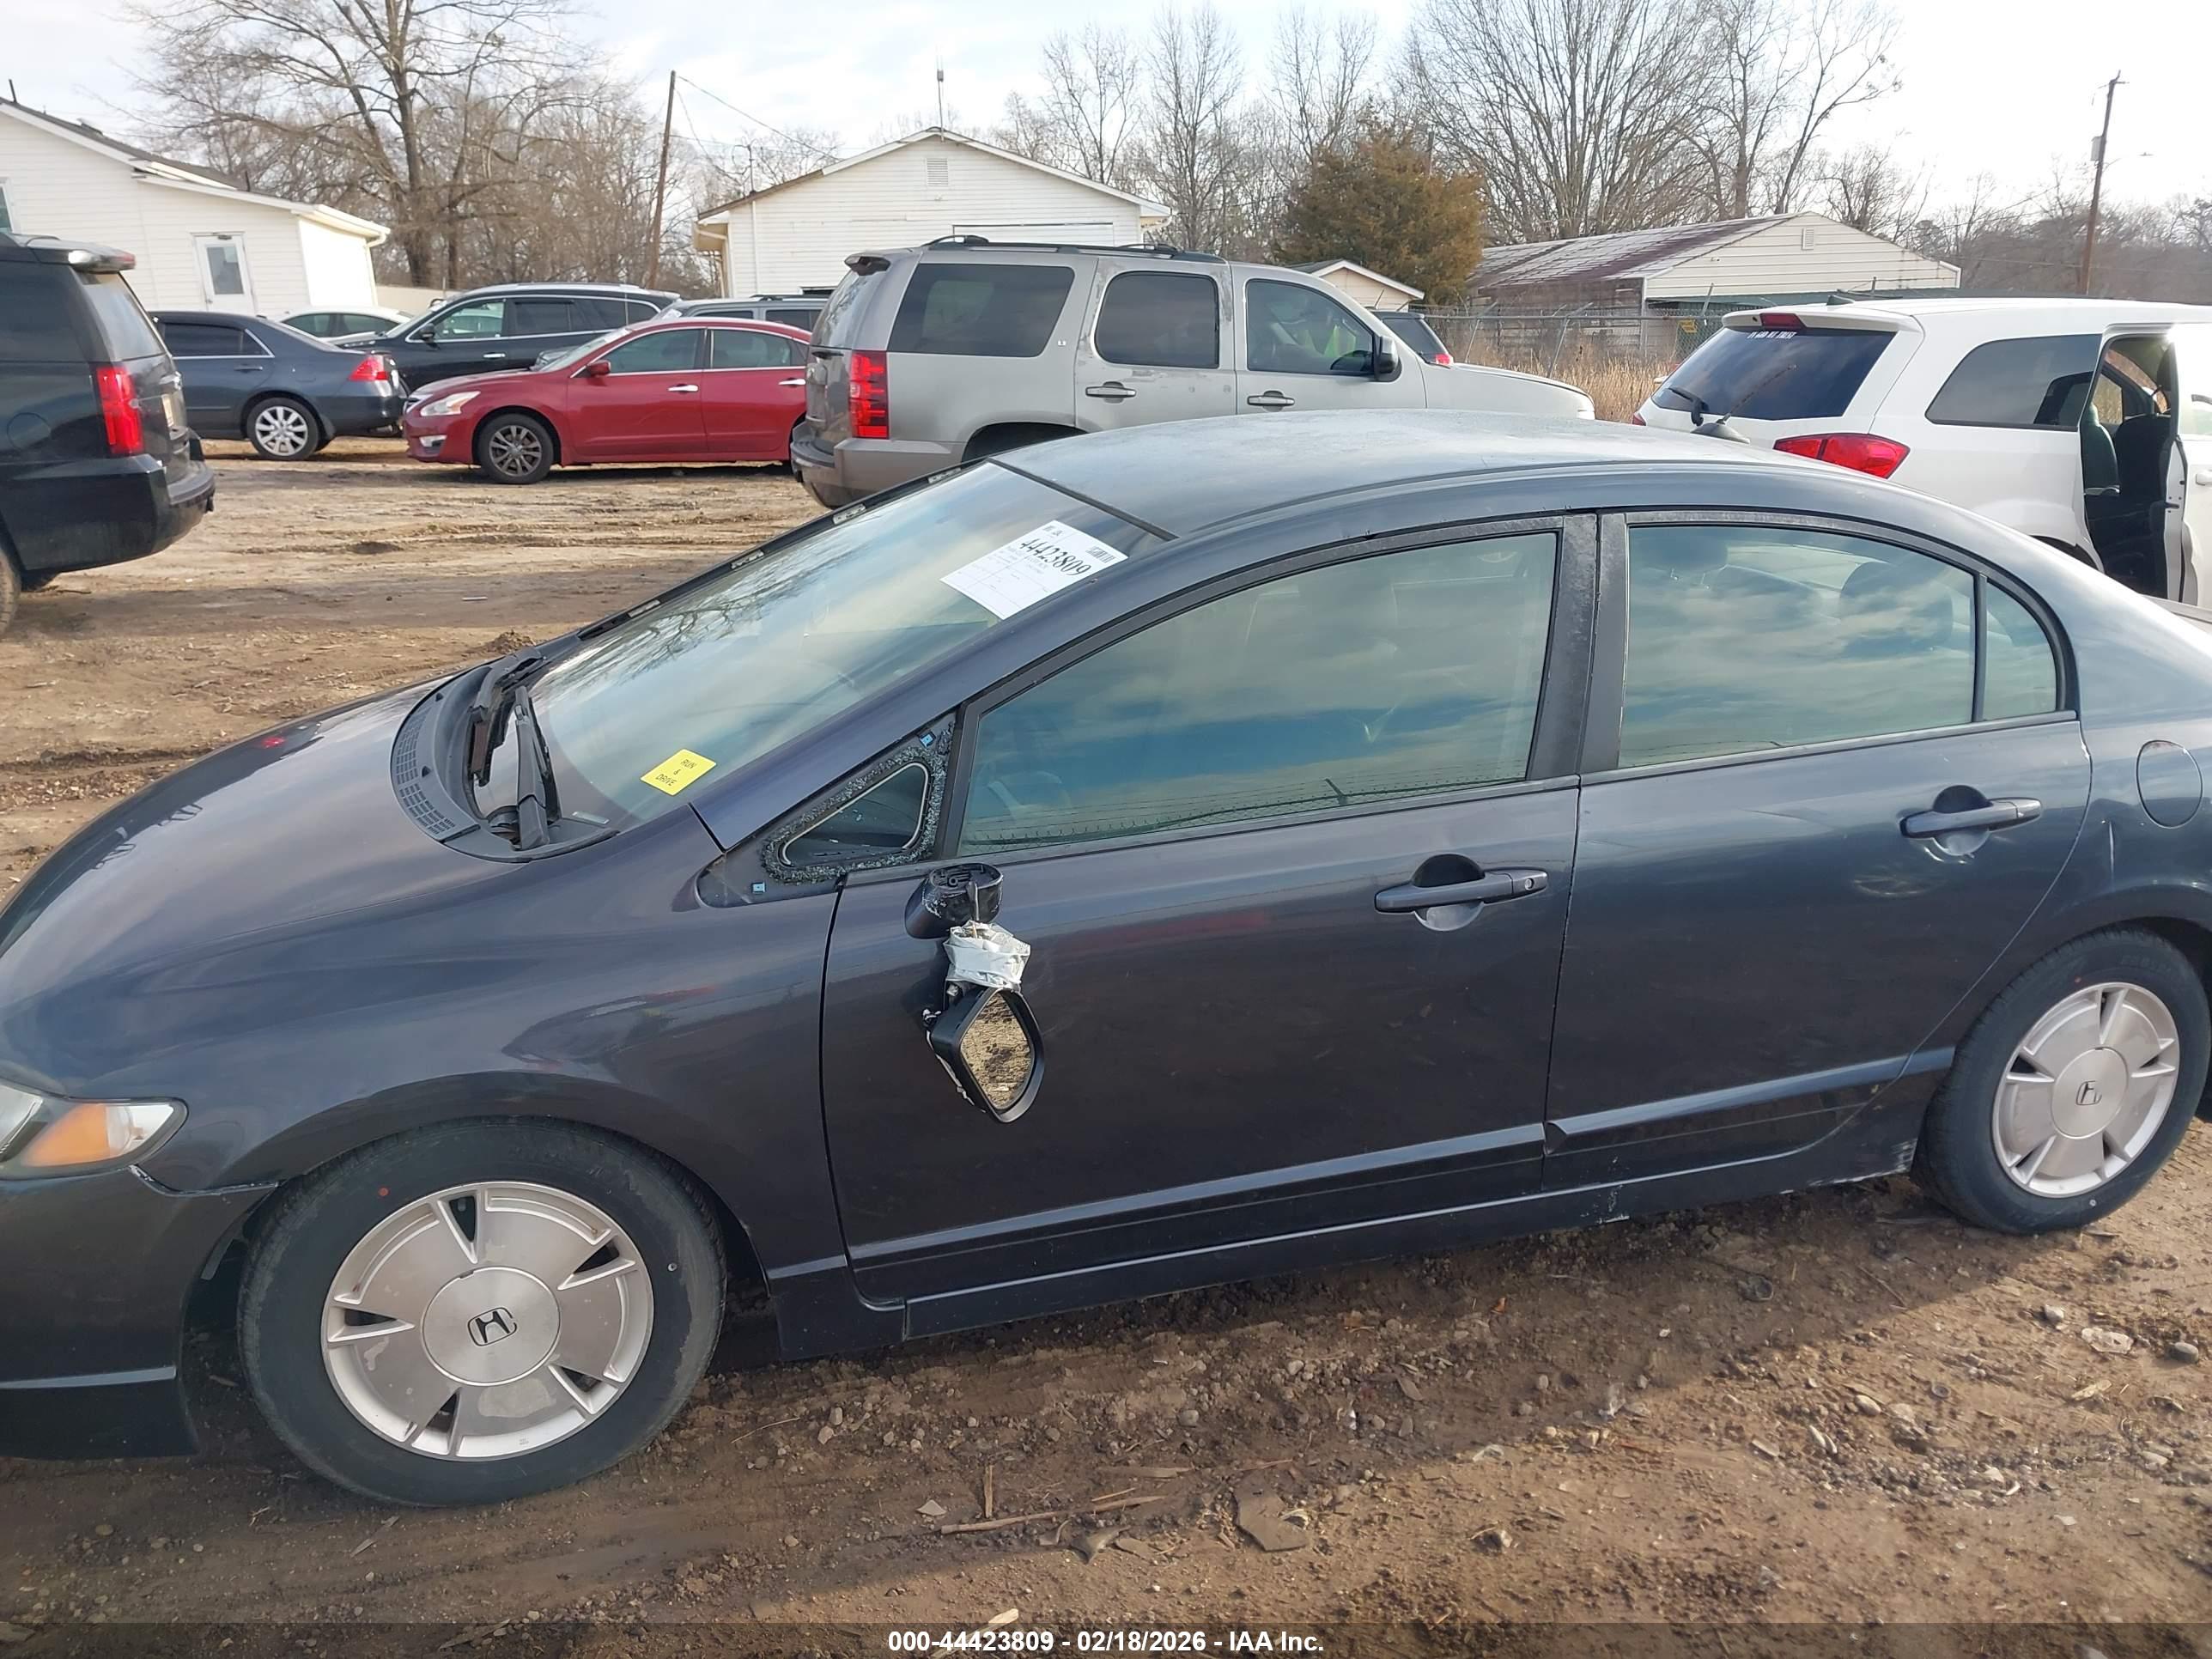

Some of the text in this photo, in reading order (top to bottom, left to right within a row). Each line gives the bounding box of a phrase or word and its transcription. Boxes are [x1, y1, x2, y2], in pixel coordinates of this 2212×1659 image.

[1019, 538, 1092, 576] 44423809
[680, 759, 698, 769] RUN
[655, 774, 678, 787] DRIVE
